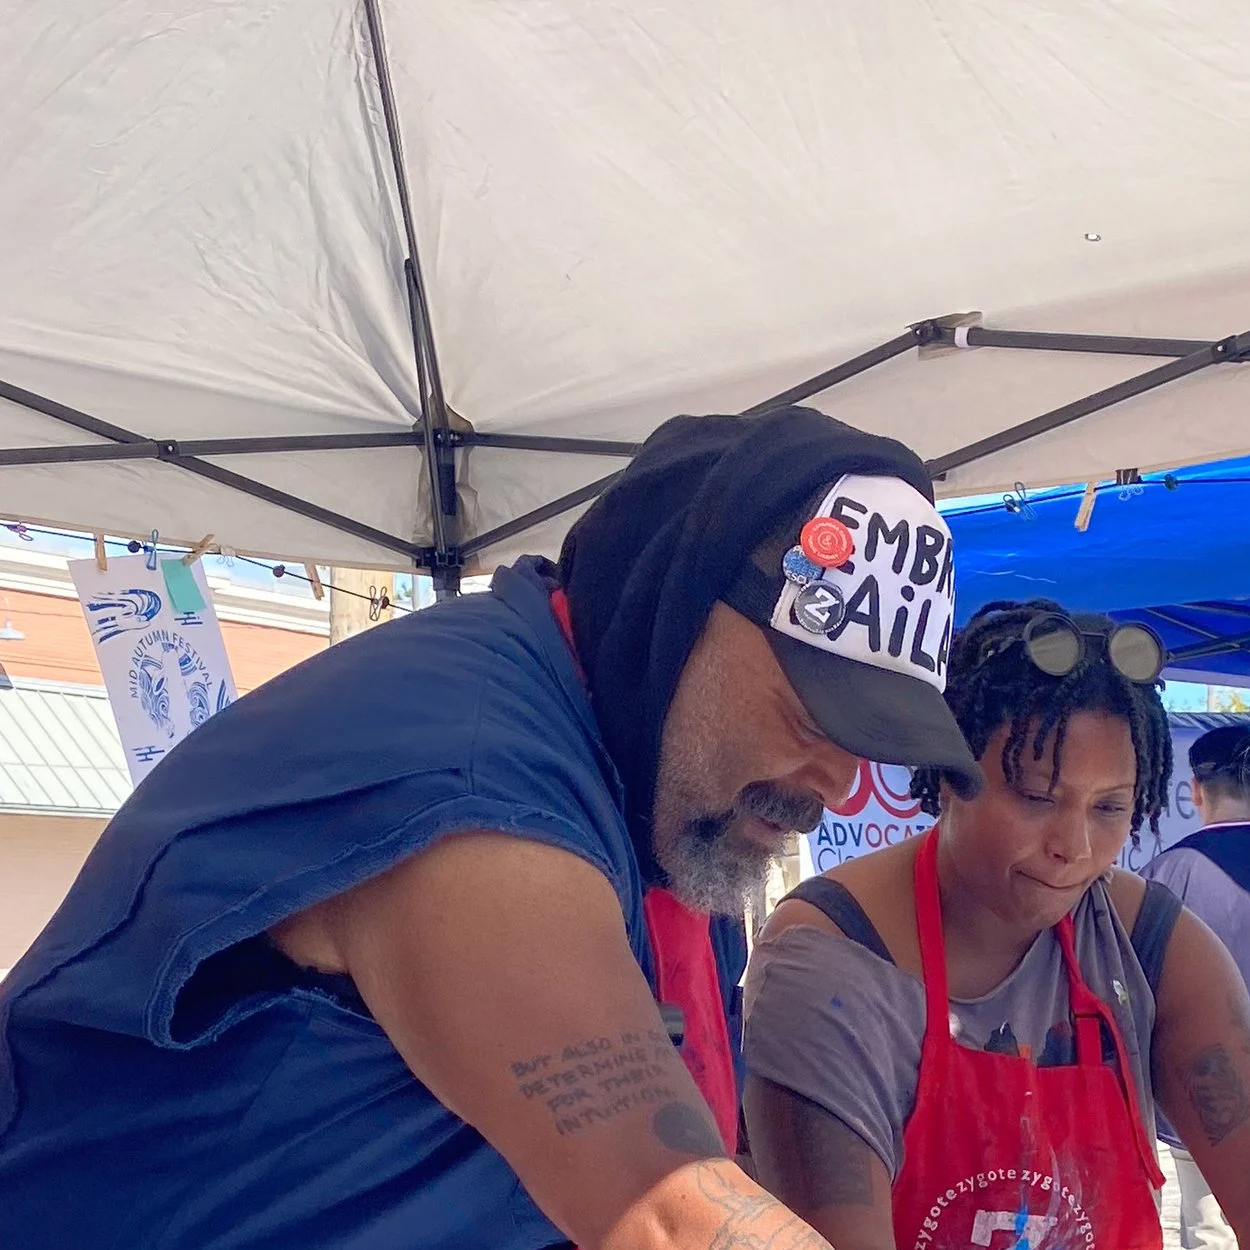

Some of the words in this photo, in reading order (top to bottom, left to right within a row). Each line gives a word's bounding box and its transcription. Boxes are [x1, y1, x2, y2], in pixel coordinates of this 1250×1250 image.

[131, 630, 170, 668] AUTUMN
[172, 632, 214, 688] FESTIVAL
[128, 669, 140, 699] MID
[817, 822, 933, 848] ADVOCA
